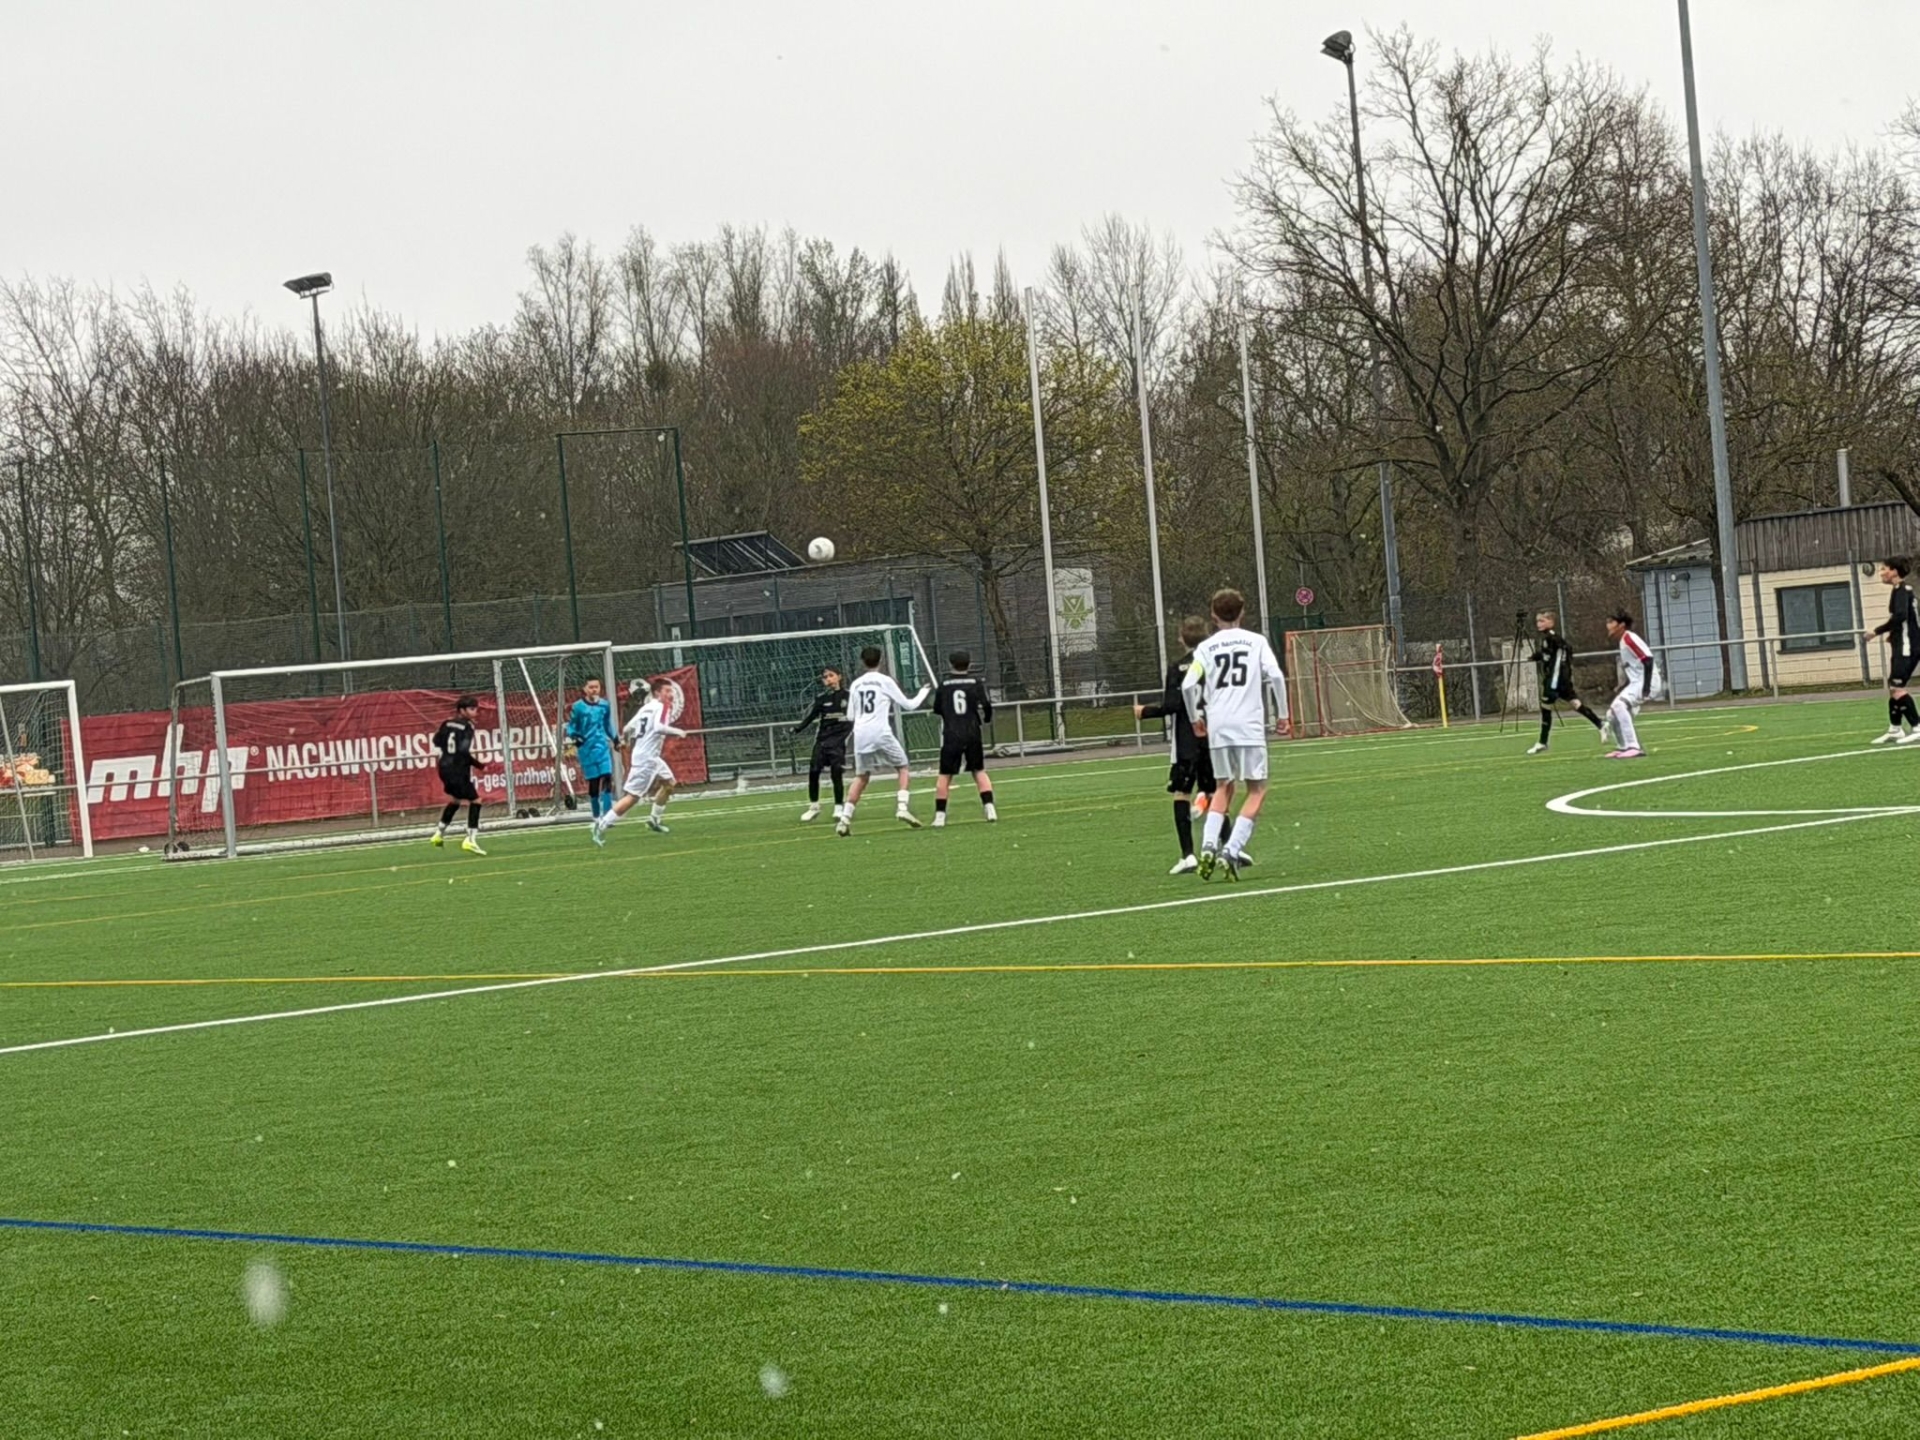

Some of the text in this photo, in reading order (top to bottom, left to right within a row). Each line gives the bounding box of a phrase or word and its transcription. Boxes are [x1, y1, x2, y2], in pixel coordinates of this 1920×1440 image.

[1214, 651, 1249, 690] 25
[858, 690, 876, 714] 13
[953, 690, 967, 715] 6
[447, 732, 457, 754] 6
